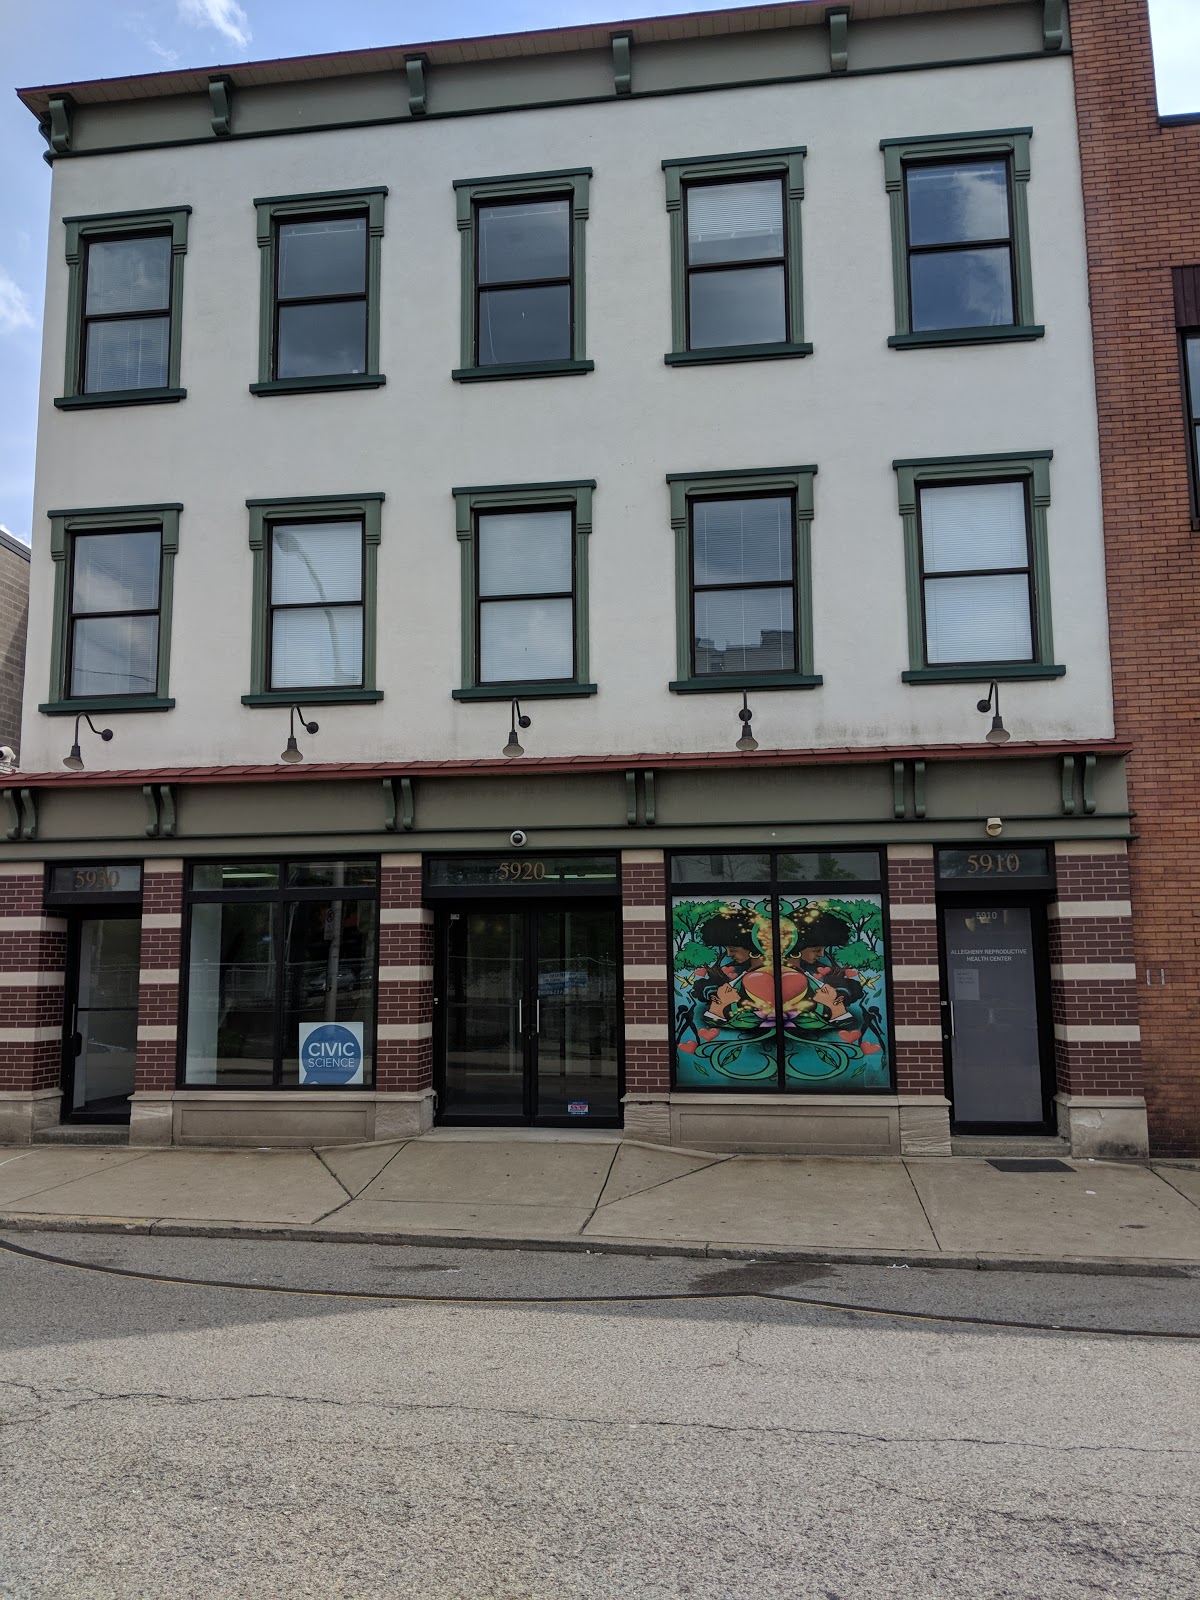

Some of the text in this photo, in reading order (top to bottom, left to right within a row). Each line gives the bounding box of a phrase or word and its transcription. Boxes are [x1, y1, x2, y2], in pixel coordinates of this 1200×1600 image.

[498, 861, 546, 881] 5920
[966, 853, 1020, 874] 5910
[74, 870, 121, 889] 5930
[975, 911, 997, 920] 5910
[308, 1042, 355, 1057] CIVIC
[308, 1057, 355, 1068] SCIENCE
